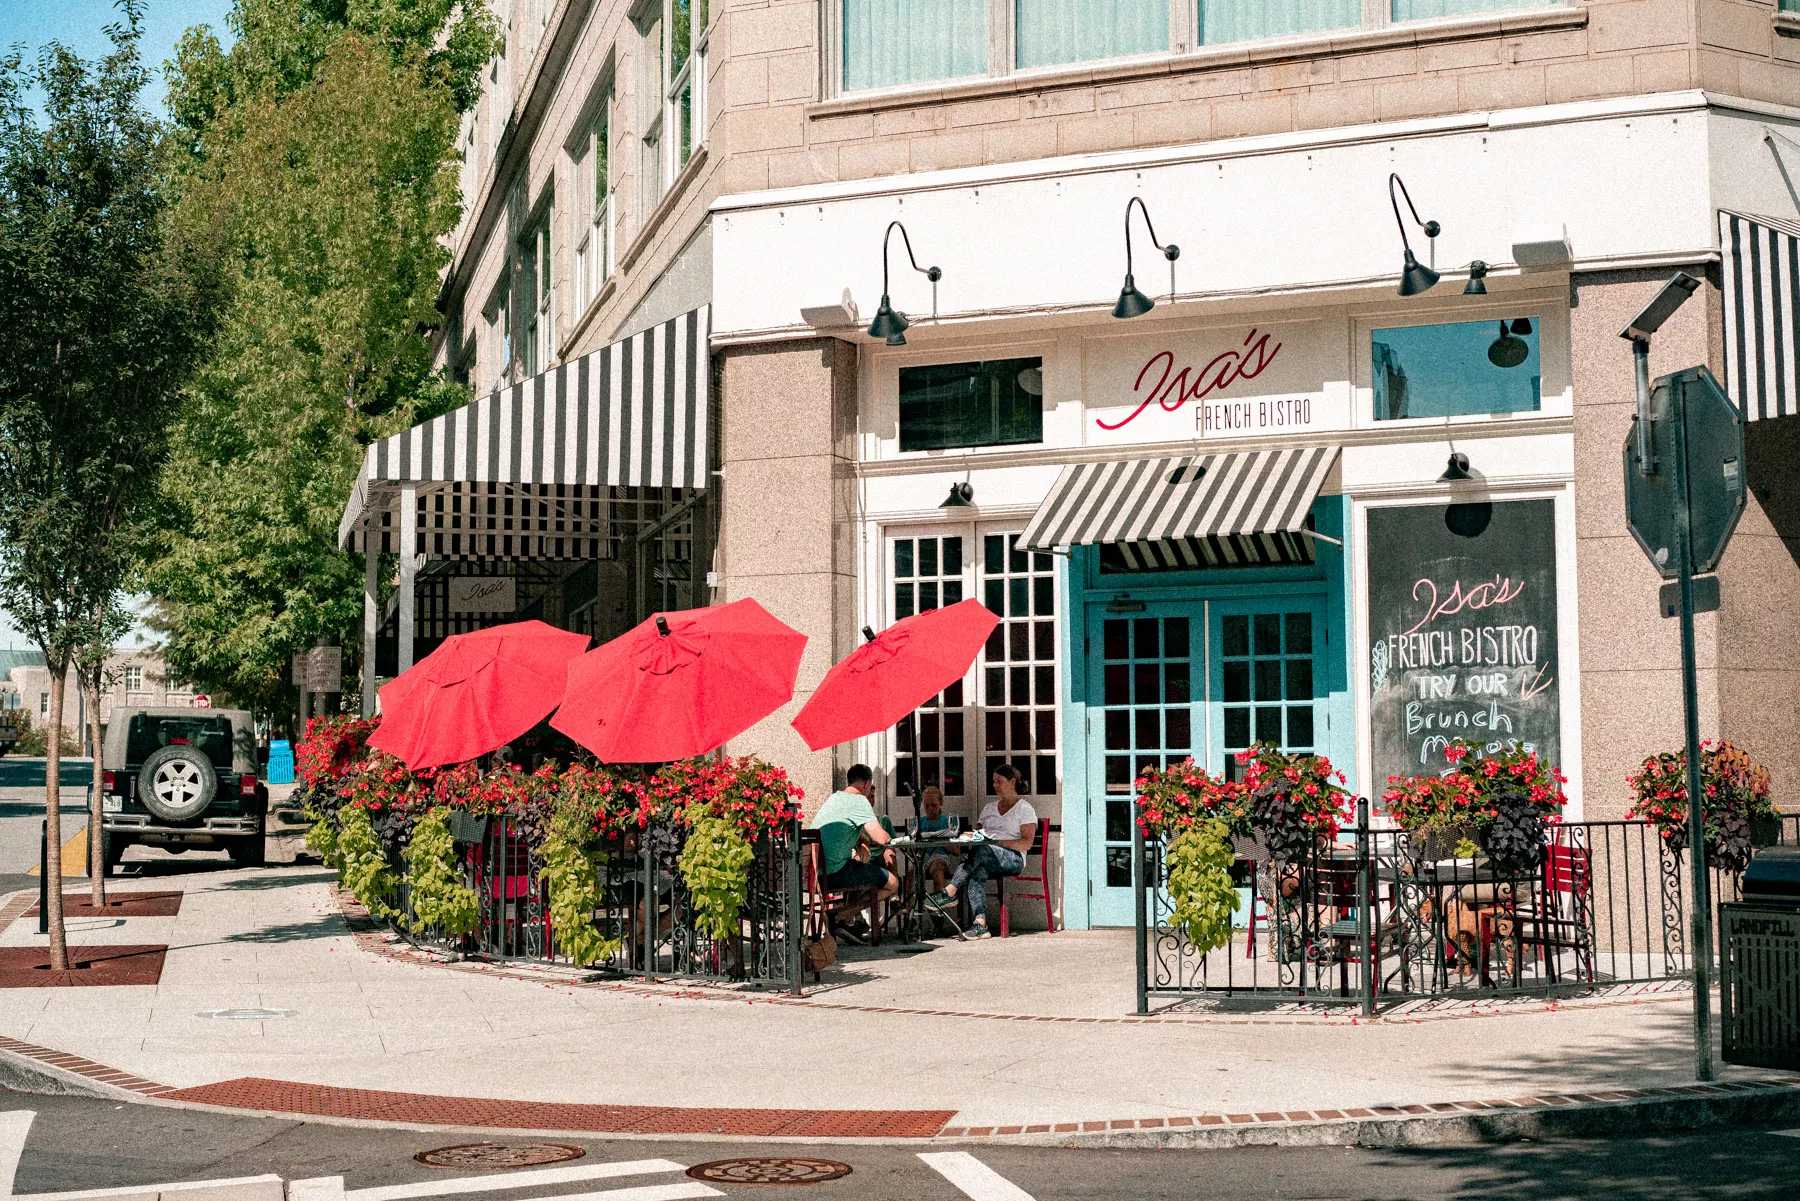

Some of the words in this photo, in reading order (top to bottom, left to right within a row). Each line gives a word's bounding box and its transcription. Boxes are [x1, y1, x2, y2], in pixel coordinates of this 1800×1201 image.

[1096, 328, 1282, 430] Isa's
[1195, 403, 1251, 431] FRENCH
[1259, 398, 1311, 427] BISTRO
[461, 579, 506, 601] Isa's
[1403, 574, 1525, 635] Isa's
[1388, 630, 1454, 669] FRENCH
[1461, 625, 1538, 665] BISTRO
[1414, 673, 1457, 700] TRY
[1468, 672, 1508, 696] OUR
[1406, 700, 1512, 738] Brunch
[1730, 917, 1795, 937] LANDFILL
